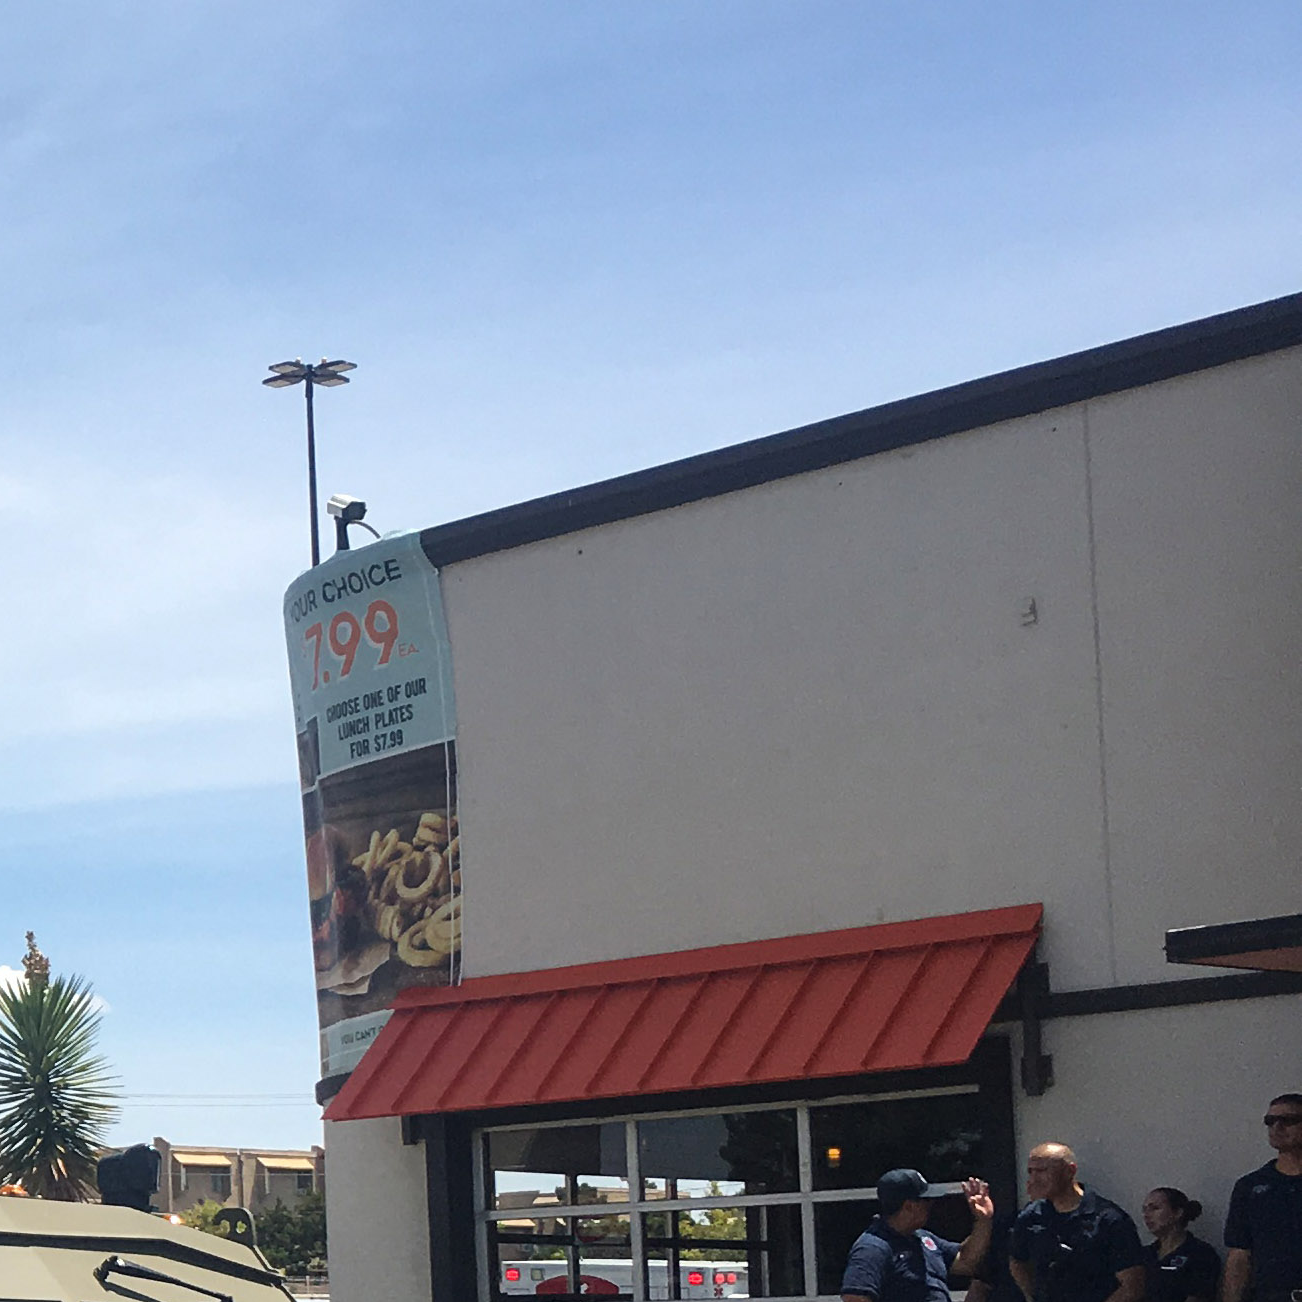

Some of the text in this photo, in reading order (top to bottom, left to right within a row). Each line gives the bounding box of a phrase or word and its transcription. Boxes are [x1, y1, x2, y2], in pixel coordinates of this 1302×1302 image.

[322, 558, 402, 602] CHOICE
[326, 677, 427, 723] CHOOSE ONE OF OUR
[337, 703, 414, 740] LUNCH PLATES
[349, 728, 404, 759] FOR $7.99
